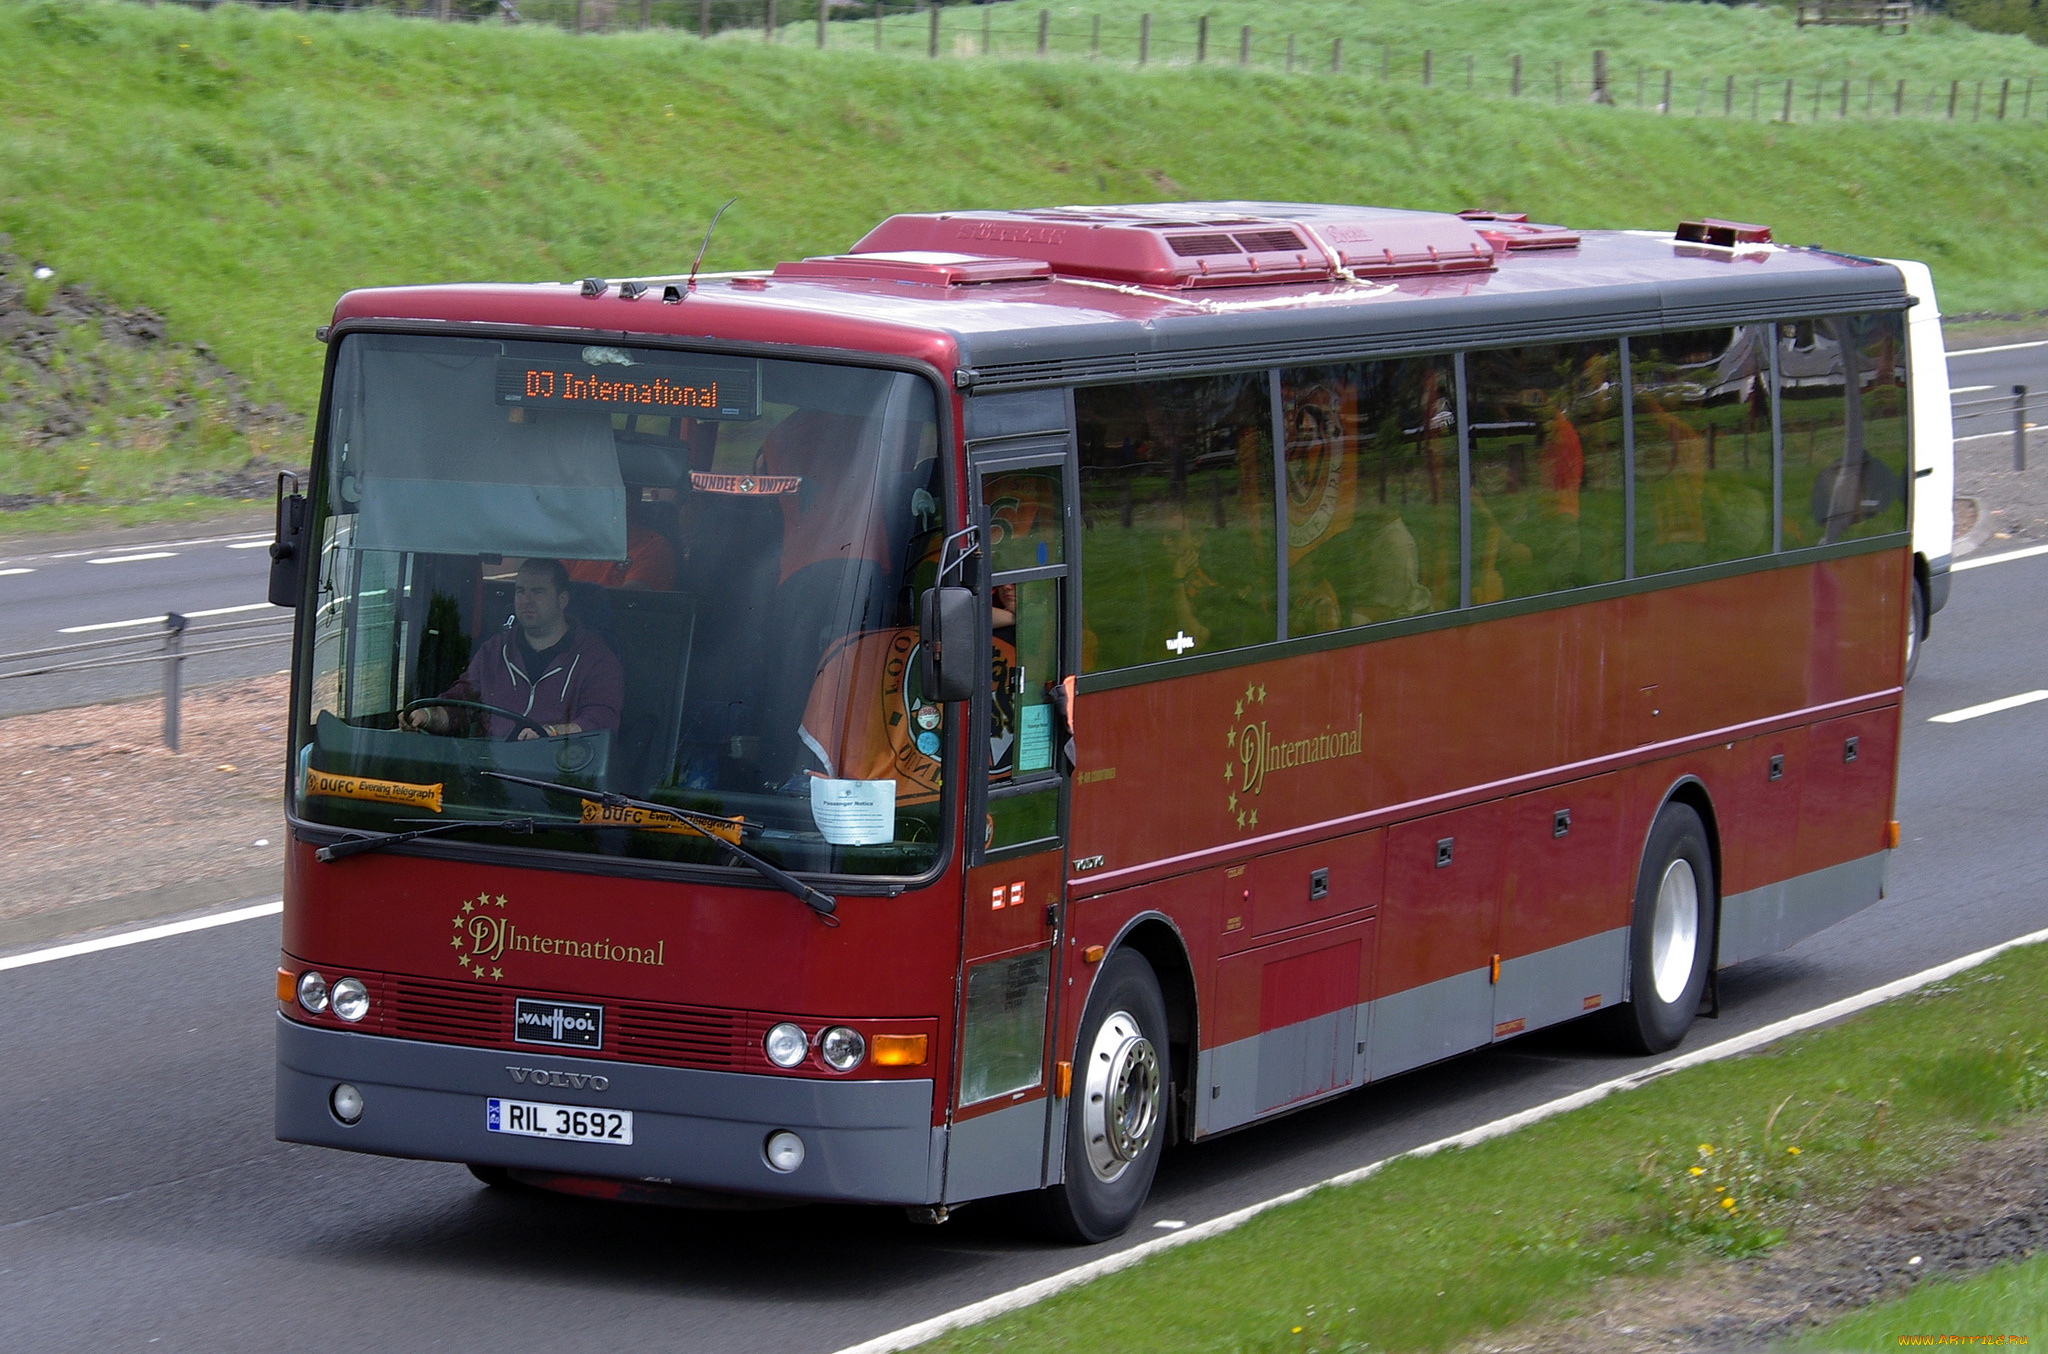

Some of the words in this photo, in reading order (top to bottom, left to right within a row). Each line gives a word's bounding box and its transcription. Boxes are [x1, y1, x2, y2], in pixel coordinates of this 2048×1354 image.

[526, 370, 554, 397] DJ
[563, 372, 717, 408] International
[693, 475, 736, 491] DUNDEE
[759, 478, 797, 493] UNITED
[1239, 720, 1268, 795] DJ
[1265, 712, 1363, 773] International
[320, 778, 354, 794] DUFC
[358, 781, 391, 796] Evening
[392, 784, 435, 800] Telegraph
[602, 807, 643, 824] DUFC
[648, 811, 686, 826] Evening
[687, 816, 736, 832] elegraph
[468, 915, 508, 962] DJ
[508, 925, 665, 966] International
[505, 1066, 610, 1092] VOLVO
[509, 1104, 547, 1132] RIL
[555, 1110, 623, 1139] 3692
